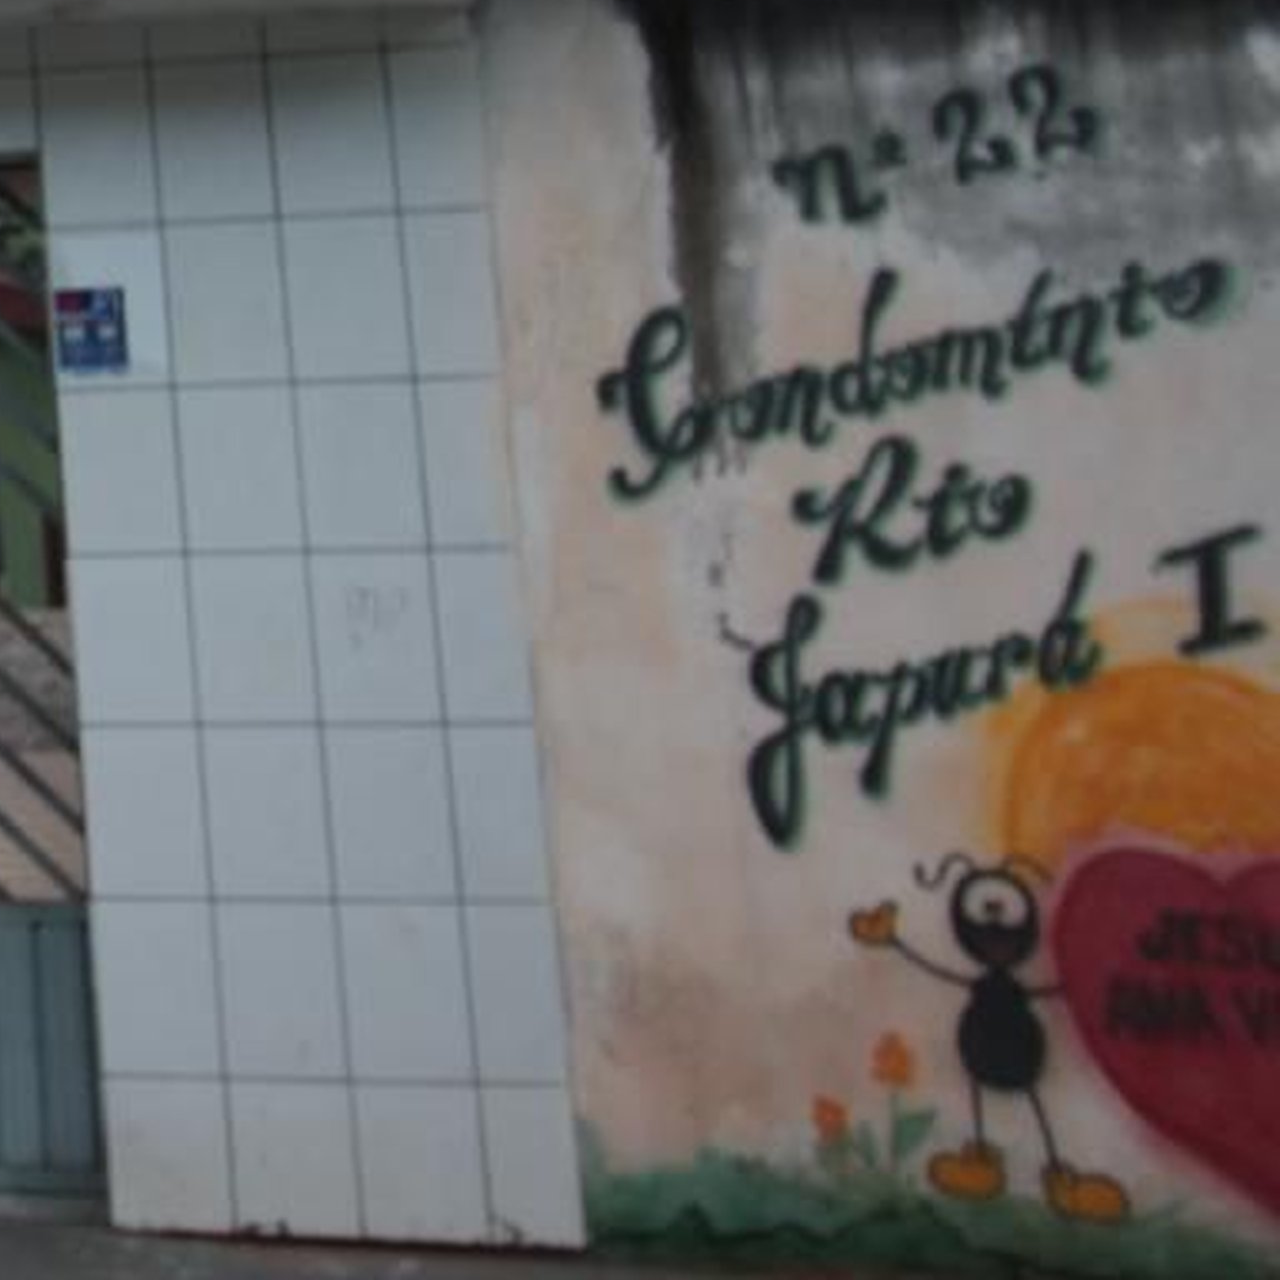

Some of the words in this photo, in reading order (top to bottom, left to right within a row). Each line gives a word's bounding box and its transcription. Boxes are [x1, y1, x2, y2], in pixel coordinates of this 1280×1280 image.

[932, 64, 1101, 186] 22
[792, 433, 1032, 583] Rio
[746, 547, 1102, 852] Japurá
[1154, 525, 1266, 656] I
